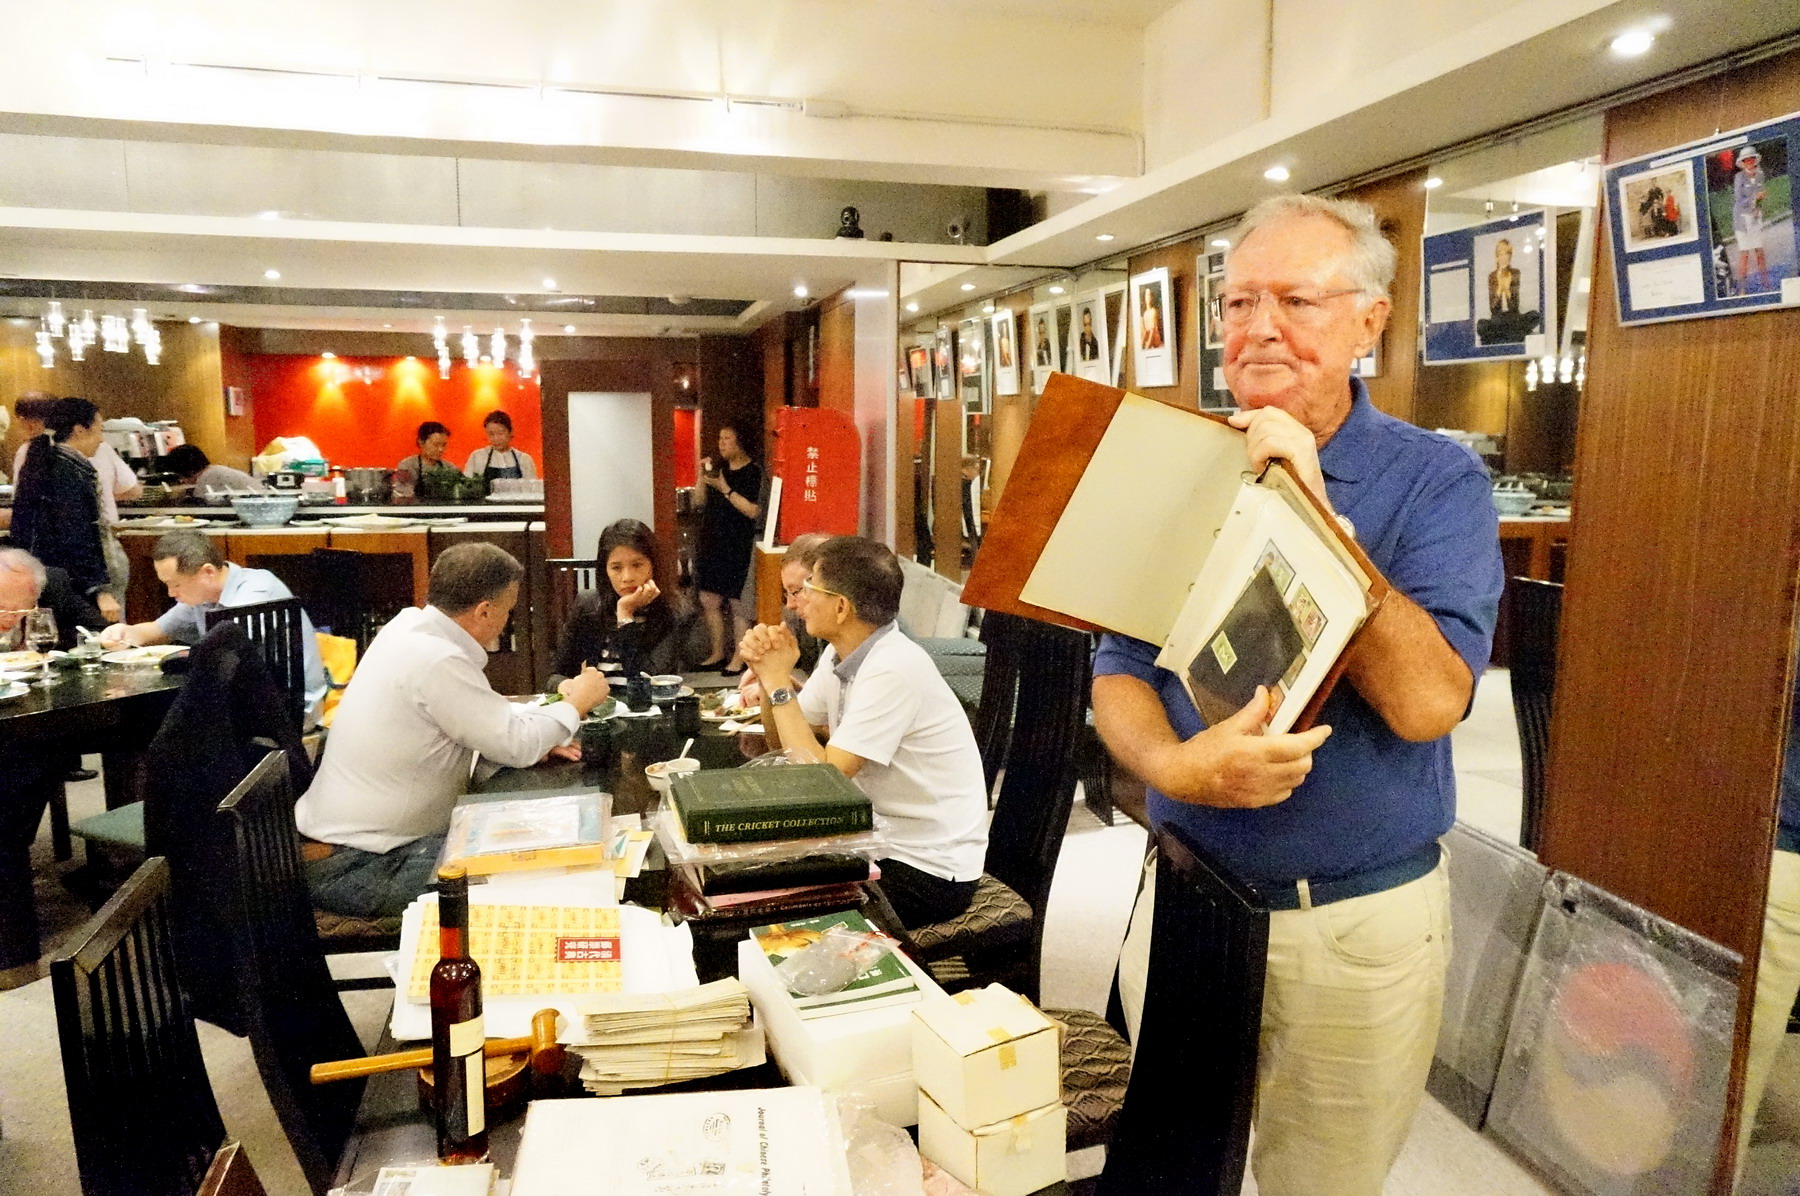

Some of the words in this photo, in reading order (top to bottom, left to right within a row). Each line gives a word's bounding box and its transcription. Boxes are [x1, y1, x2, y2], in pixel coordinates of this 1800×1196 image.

[715, 823, 735, 832] THE
[738, 820, 780, 831] CRICKET
[783, 816, 844, 828] COLLECTION
[757, 1106, 767, 1131] Journal
[759, 1132, 768, 1140] of
[760, 1141, 769, 1165] Chinese
